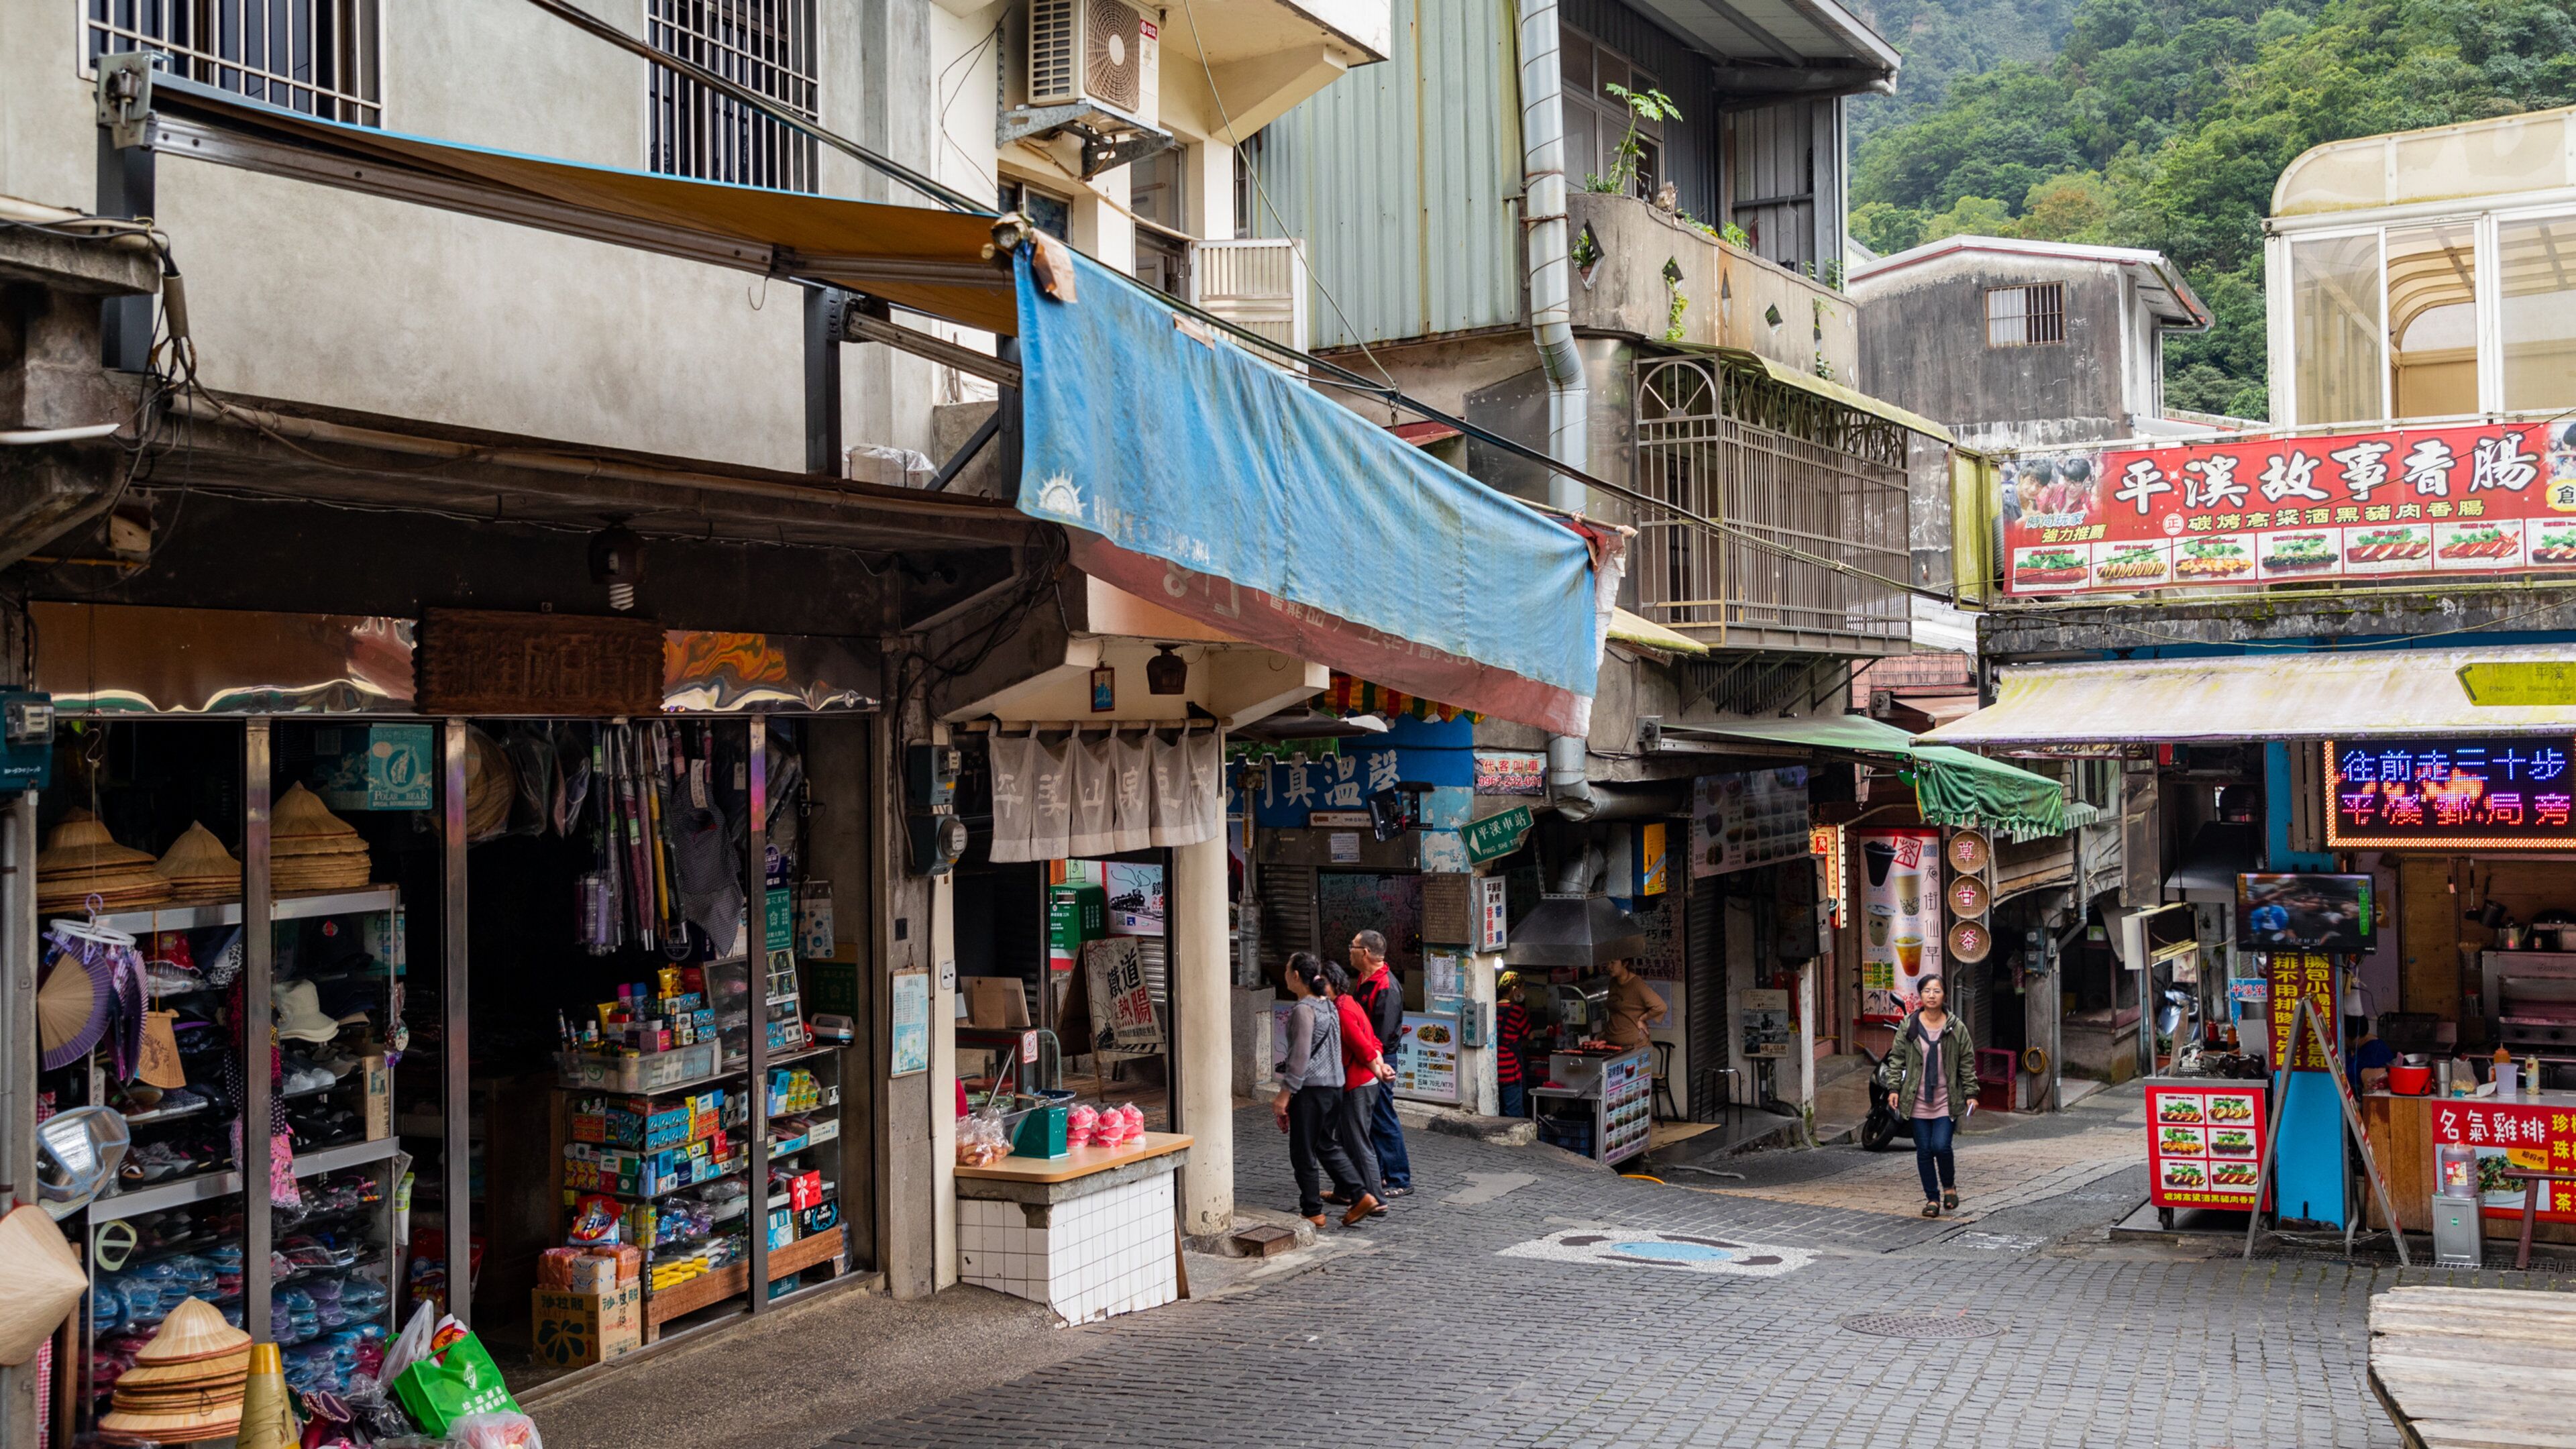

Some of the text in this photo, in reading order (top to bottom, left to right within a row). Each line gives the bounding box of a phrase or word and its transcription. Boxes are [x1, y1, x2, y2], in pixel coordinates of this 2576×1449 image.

[2115, 431, 2538, 514] 平溪故事香腸
[2025, 512, 2086, 529] 時尚玩家
[2041, 523, 2107, 543] 強力推薦
[1483, 759, 1540, 773] 代客叫車
[2343, 748, 2566, 782] 往前走三十步
[1477, 811, 1527, 841] 平溪車站
[1483, 847, 1496, 855] PING
[1498, 842, 1508, 850] SHI
[1923, 865, 1940, 965] 老街仙草
[1107, 947, 1141, 1000] 鐵道
[2231, 984, 2267, 998] 平溪芋
[1118, 986, 1152, 1027] 熱腸
[2439, 1108, 2546, 1144] 名氣雞排
[2522, 1150, 2545, 1165] 超好吃
